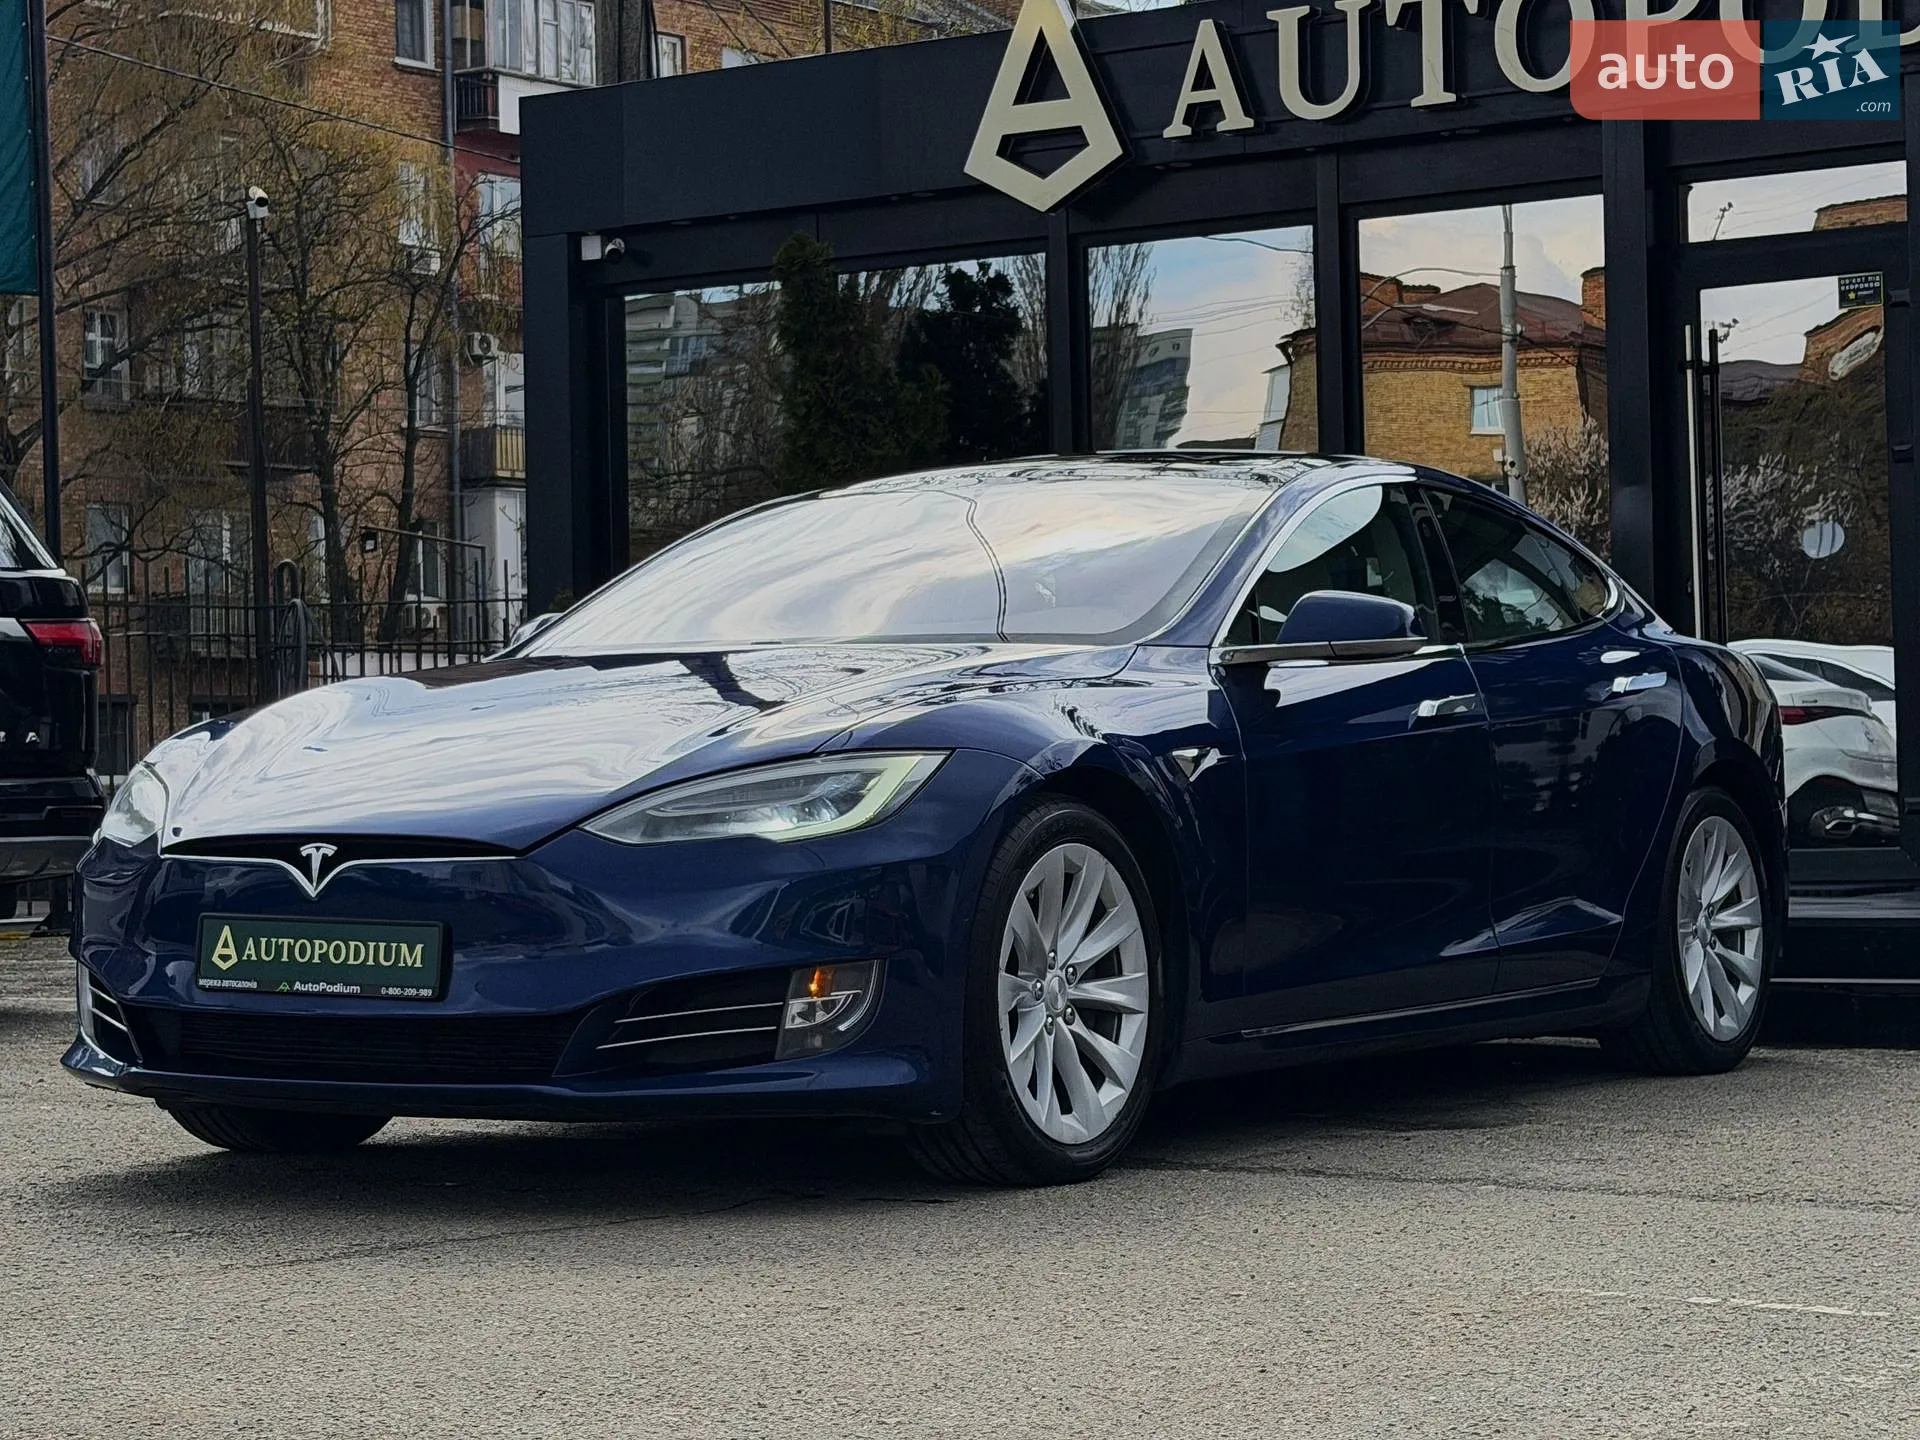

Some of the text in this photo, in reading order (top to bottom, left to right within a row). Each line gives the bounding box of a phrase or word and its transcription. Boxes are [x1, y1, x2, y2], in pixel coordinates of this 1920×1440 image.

[242, 936, 424, 968] AUTOPODIUM
[293, 981, 361, 994] AutoPodium
[381, 987, 432, 997] 0-800-209-989
